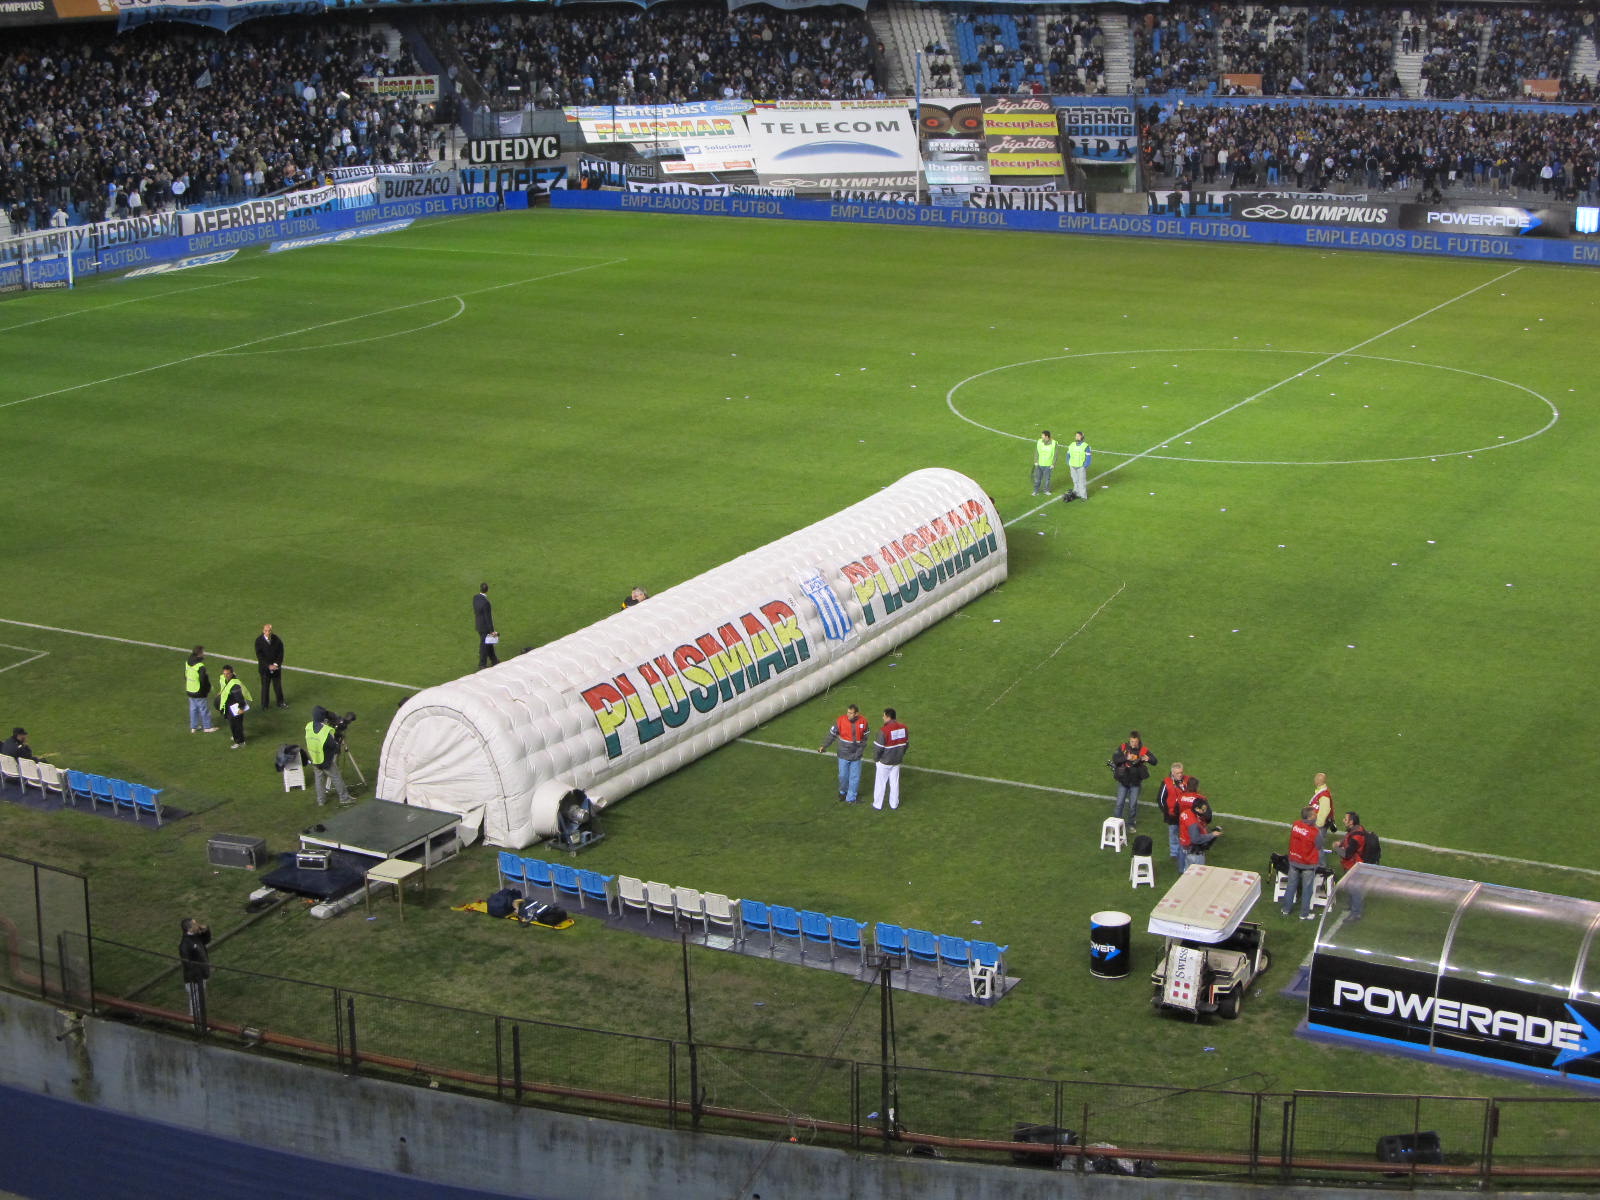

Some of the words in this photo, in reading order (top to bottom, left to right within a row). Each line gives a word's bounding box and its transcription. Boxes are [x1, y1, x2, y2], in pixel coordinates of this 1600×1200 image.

[358, 78, 435, 97] LUSMAR
[614, 103, 708, 119] Sinteplast
[1068, 113, 1133, 125] GRAND
[594, 118, 735, 140] PLUSMAR
[761, 121, 900, 134] TELECOM
[986, 120, 1057, 130] Recuplast
[471, 136, 558, 162] UTEDYC
[990, 158, 1062, 169] Recuplast
[385, 176, 450, 198] BURZACO
[819, 176, 919, 188] OLYMPIKUS
[339, 184, 376, 209] RAMOS
[621, 195, 700, 212] EMPLEADOS
[704, 199, 727, 213] DEL
[732, 200, 783, 215] FUTBOL
[355, 203, 421, 223] EMPLEADOS
[425, 200, 448, 213] DEL
[452, 195, 499, 210] FUTBO
[831, 205, 916, 220] EMPLEADOS
[920, 208, 946, 222] DEL
[951, 210, 1007, 225] FUTBOL
[1290, 204, 1388, 223] OLYMPIKUS
[1427, 211, 1530, 228] POWERADE
[108, 212, 177, 244] CONDENA
[189, 226, 255, 251] EMPLEADOS
[258, 224, 278, 243] DEL
[280, 217, 320, 238] FUTBOL
[1059, 215, 1151, 232] EMPLEADOS
[1156, 220, 1185, 235] DEL
[1190, 222, 1251, 239] FUTBOL
[1306, 228, 1406, 247] EMPLEADOS
[1412, 235, 1442, 251] DEL
[1447, 237, 1514, 255] FUTBOL
[104, 246, 150, 268] FUTBOL
[841, 499, 998, 626] PLUSMAR
[581, 600, 811, 760] PLUSMAR
[1175, 946, 1189, 979] SWISS
[1333, 979, 1583, 1051] POWERADE
